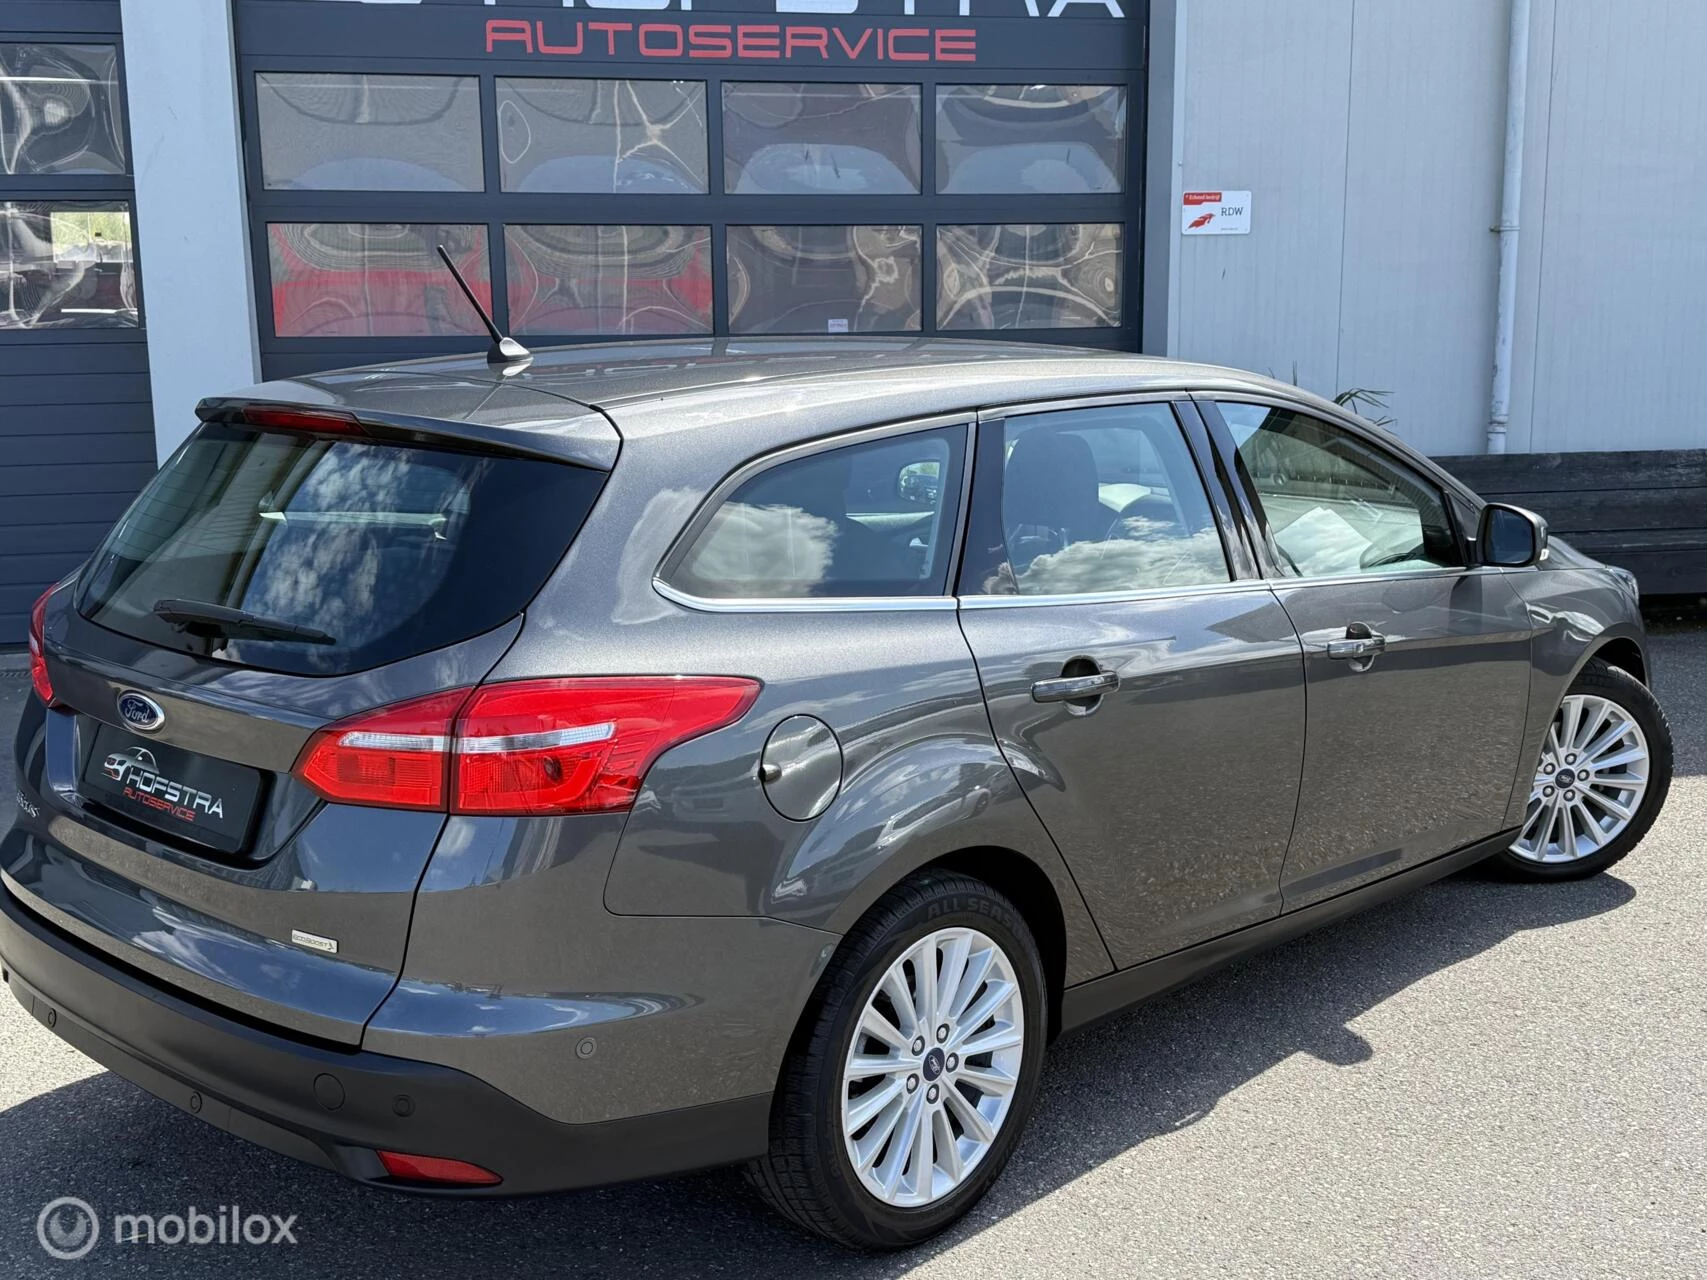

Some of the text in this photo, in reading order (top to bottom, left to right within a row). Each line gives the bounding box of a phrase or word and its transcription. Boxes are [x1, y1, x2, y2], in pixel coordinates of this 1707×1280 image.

[486, 19, 976, 62] AUTOSERVICE
[1221, 207, 1243, 216] RDW
[125, 699, 149, 723] Ford
[123, 786, 196, 821] AUTOSERVICE
[126, 767, 223, 818] HOFSTRA
[927, 901, 961, 920] ALL
